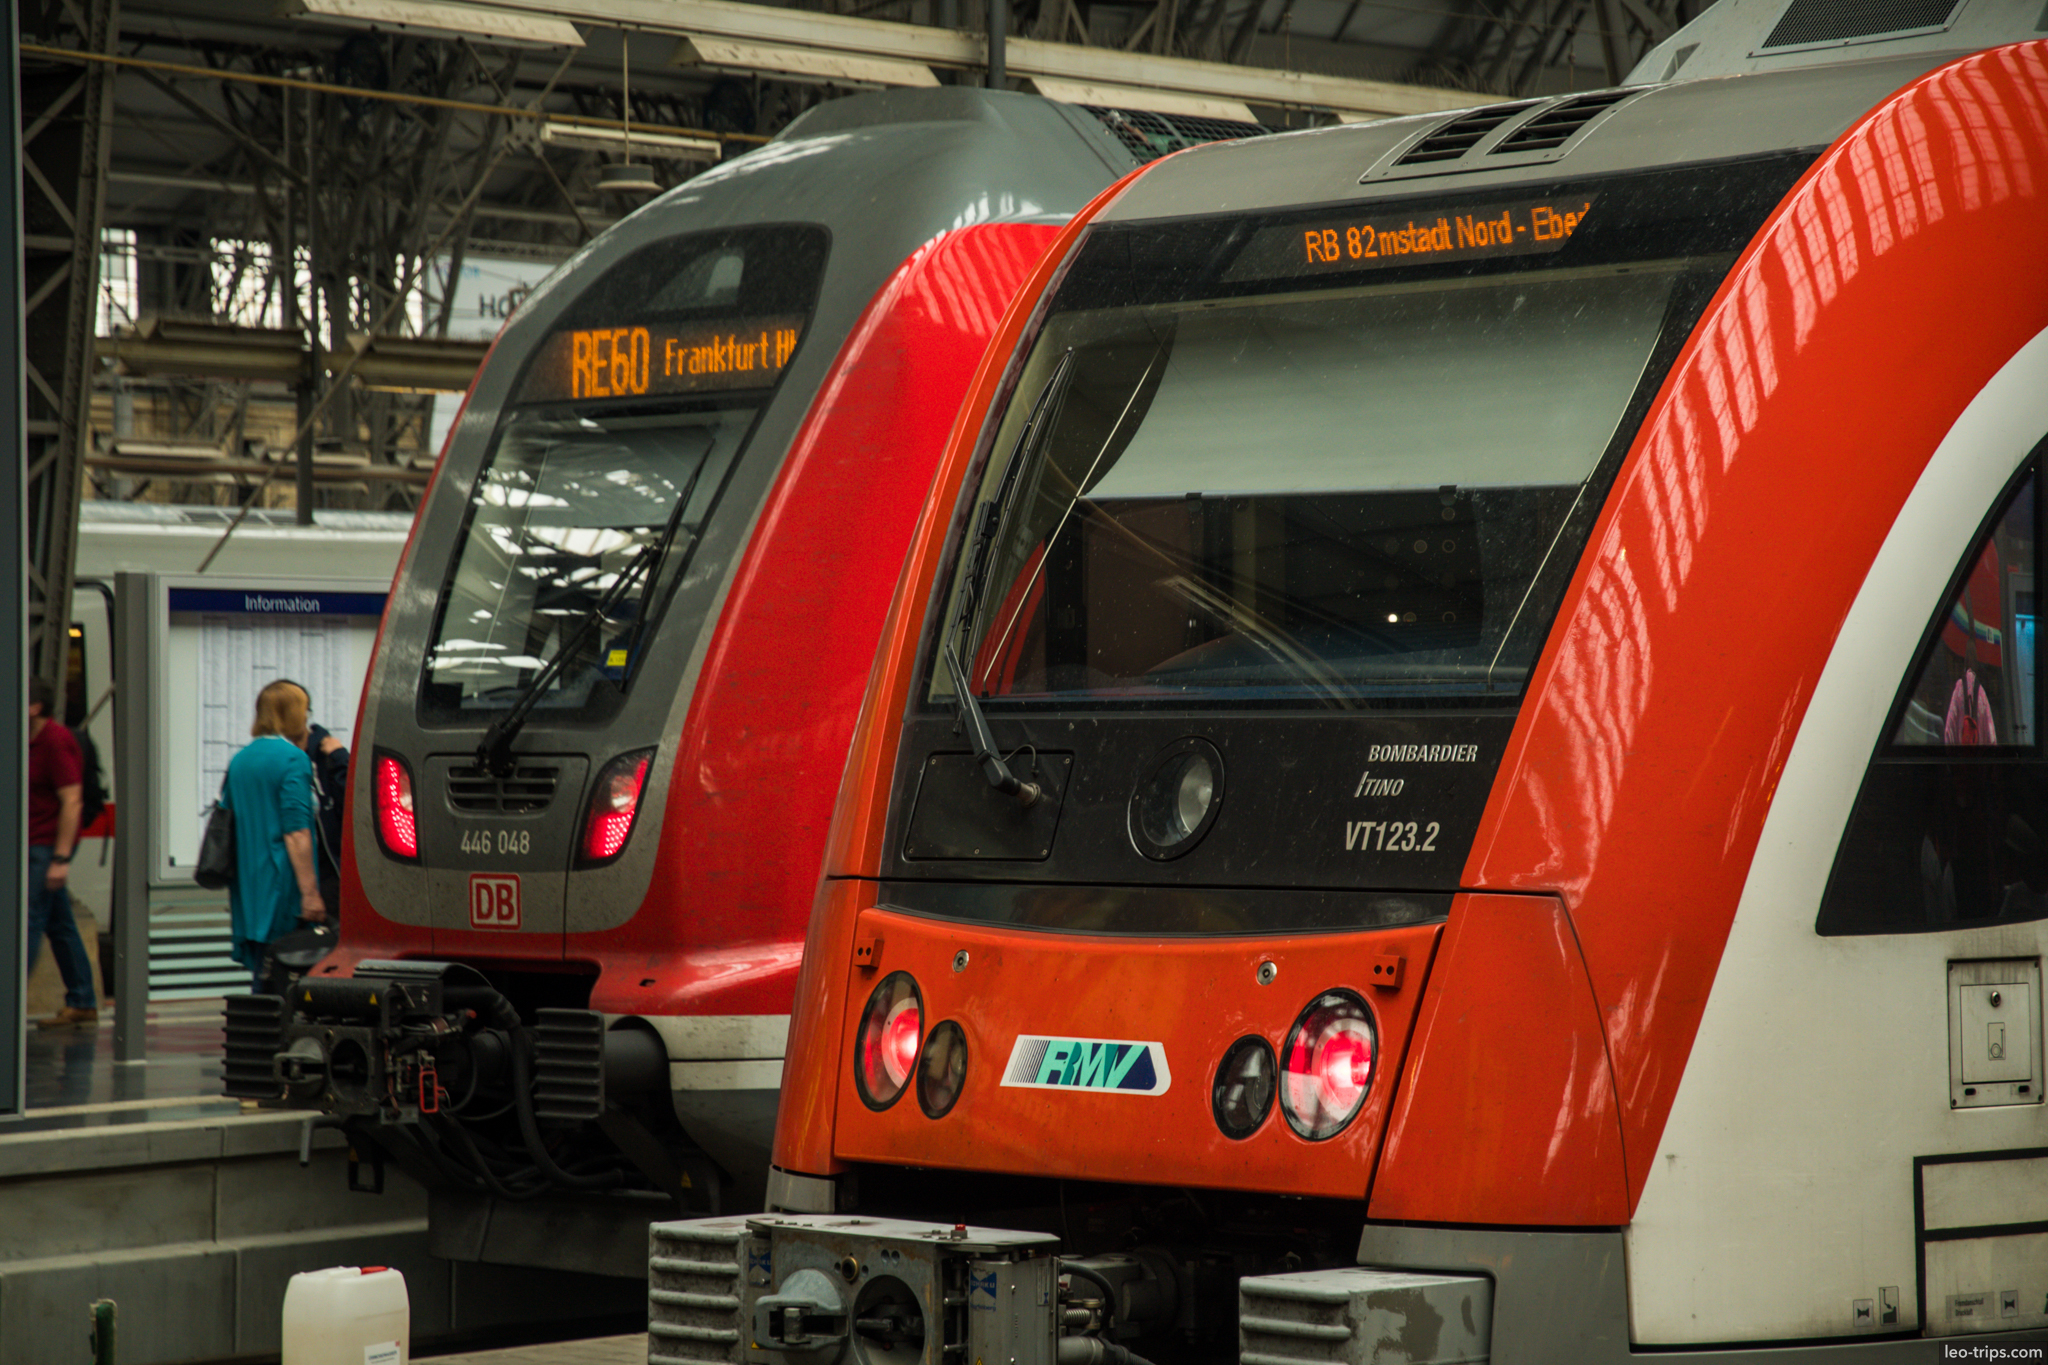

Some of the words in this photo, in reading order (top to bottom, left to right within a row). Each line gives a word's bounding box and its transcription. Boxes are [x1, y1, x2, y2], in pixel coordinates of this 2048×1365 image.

[1304, 229, 1341, 263] RB
[1456, 210, 1513, 249] Nord
[573, 327, 650, 398] RE60
[665, 331, 769, 376] Frankfurt
[245, 594, 320, 612] Information
[1368, 744, 1478, 762] BOMBARDIER
[461, 830, 491, 854] 446
[498, 830, 530, 854] 048
[1346, 821, 1440, 851] VT123.2
[475, 883, 515, 920] DB
[1034, 1040, 1148, 1088] RMV
